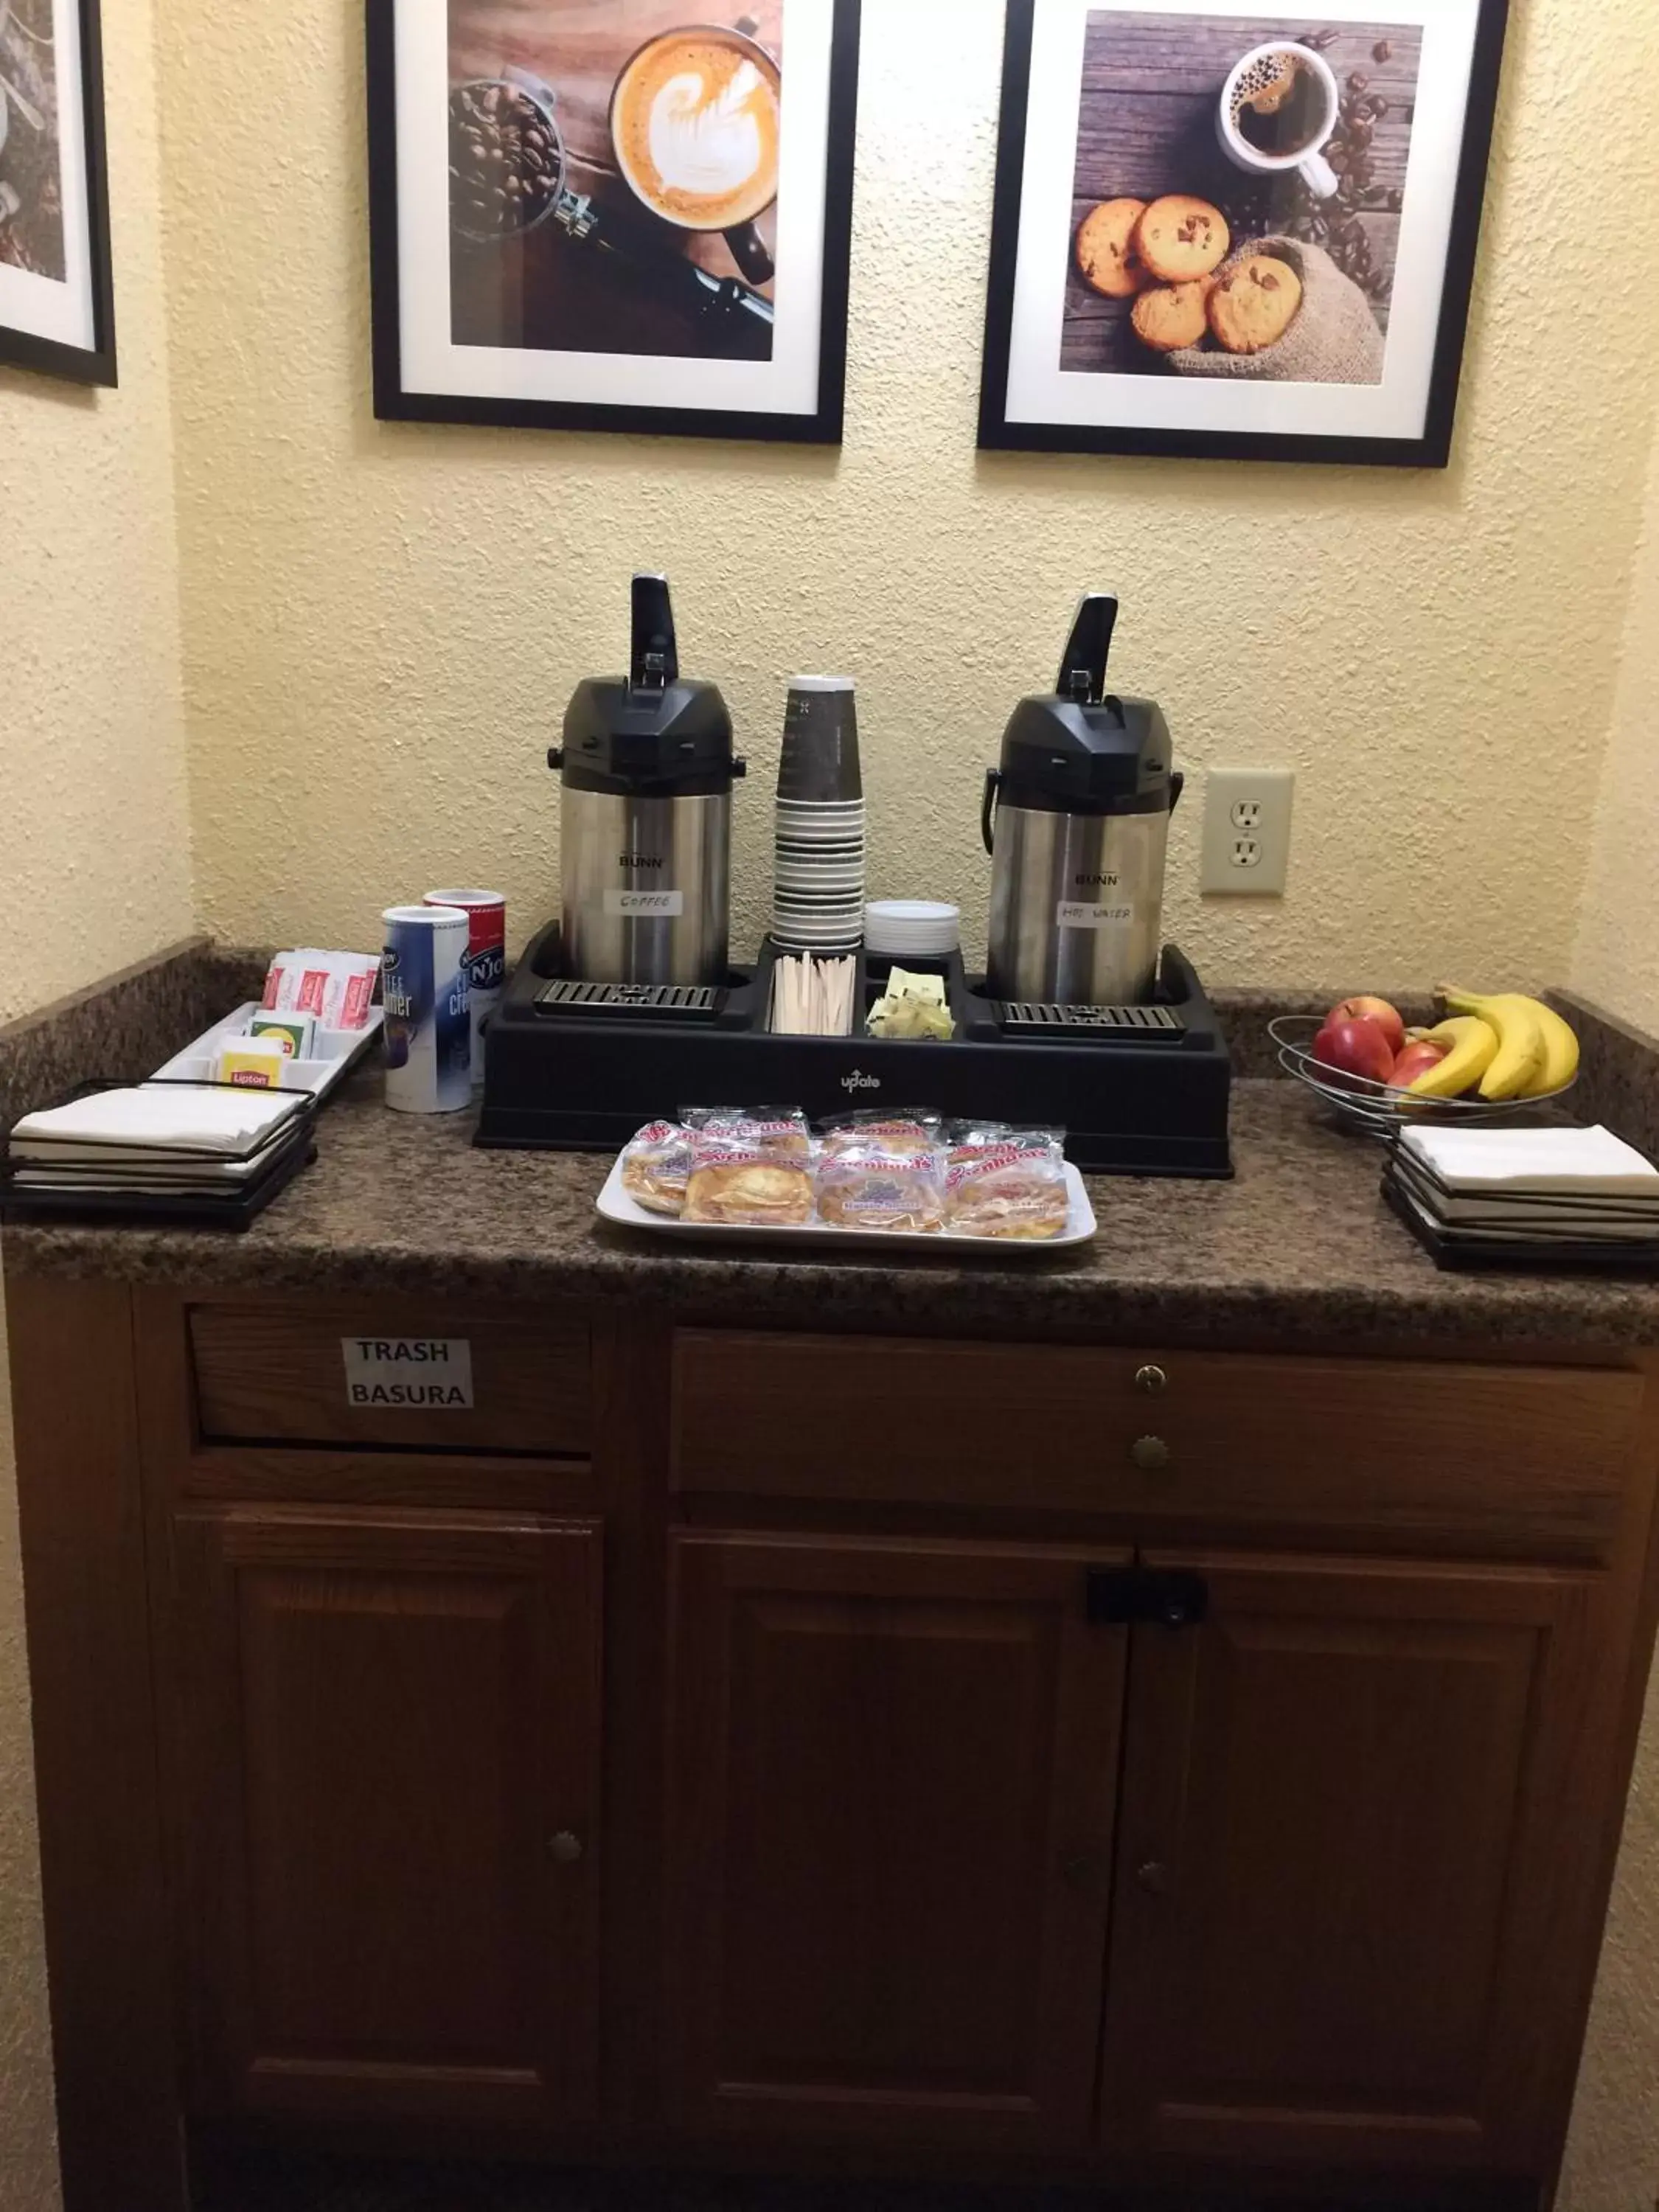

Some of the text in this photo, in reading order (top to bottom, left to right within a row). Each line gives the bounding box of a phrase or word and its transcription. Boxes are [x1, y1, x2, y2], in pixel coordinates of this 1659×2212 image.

[619, 856, 662, 869] BUNN
[1074, 874, 1118, 886] BUNN
[620, 896, 670, 907] COFFEE
[473, 957, 503, 984] N'JO
[234, 1073, 267, 1085] Lipton
[356, 1342, 448, 1361] TRASH
[352, 1383, 466, 1405] BASURA
